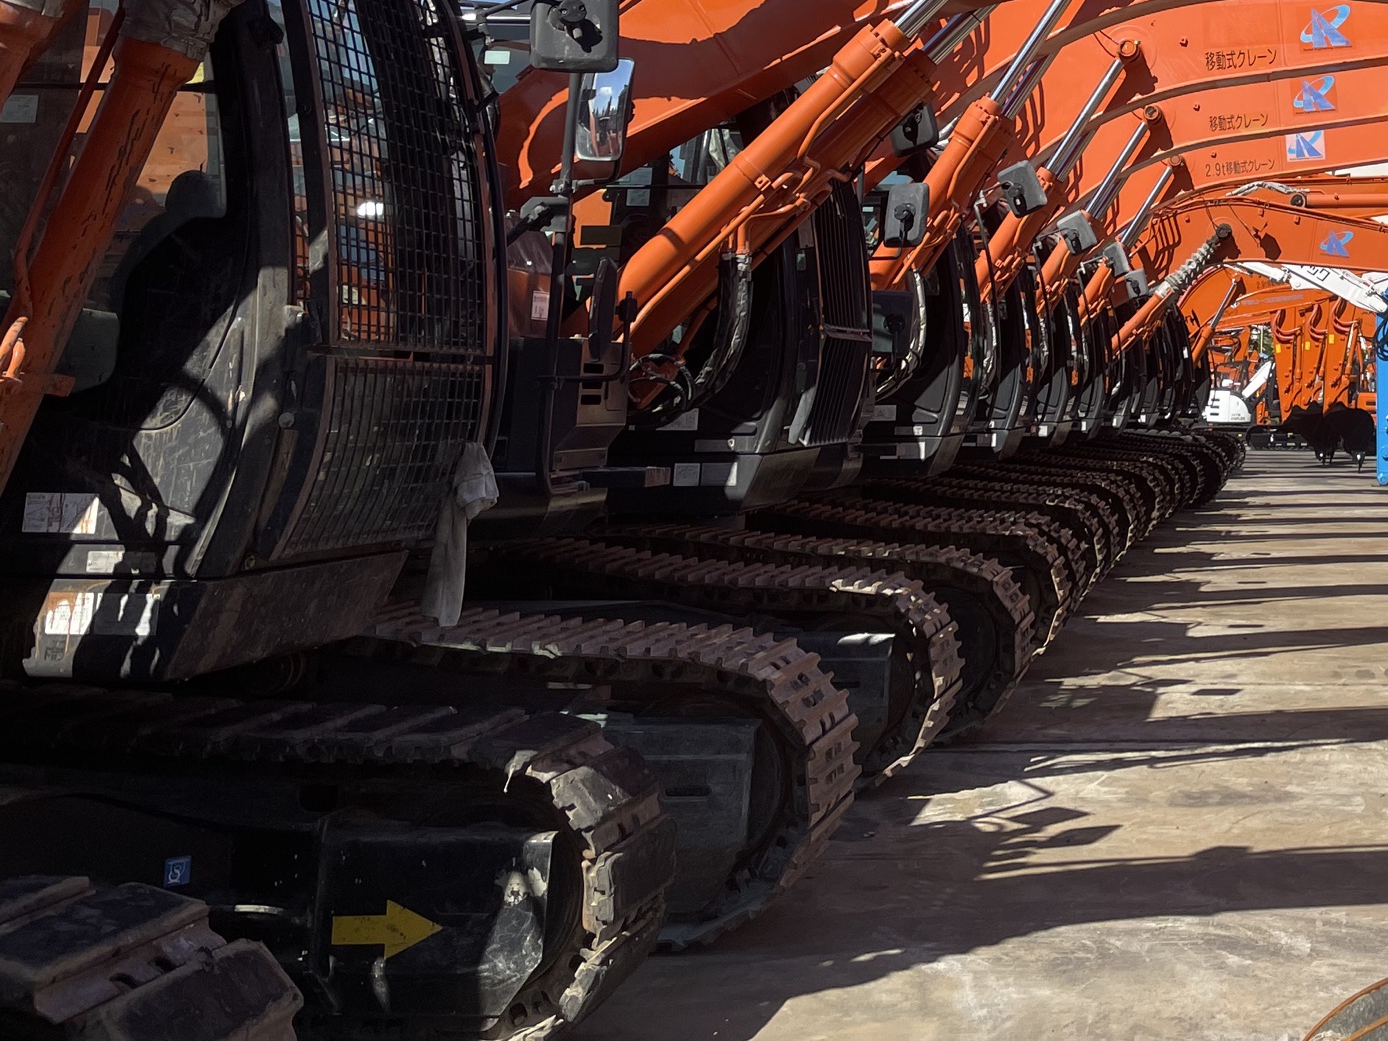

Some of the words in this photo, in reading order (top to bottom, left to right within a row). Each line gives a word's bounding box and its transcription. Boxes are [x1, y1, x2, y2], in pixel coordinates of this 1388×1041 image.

[1204, 49, 1277, 71] 移動式クレーン
[1209, 113, 1269, 131] 移動式クレーン
